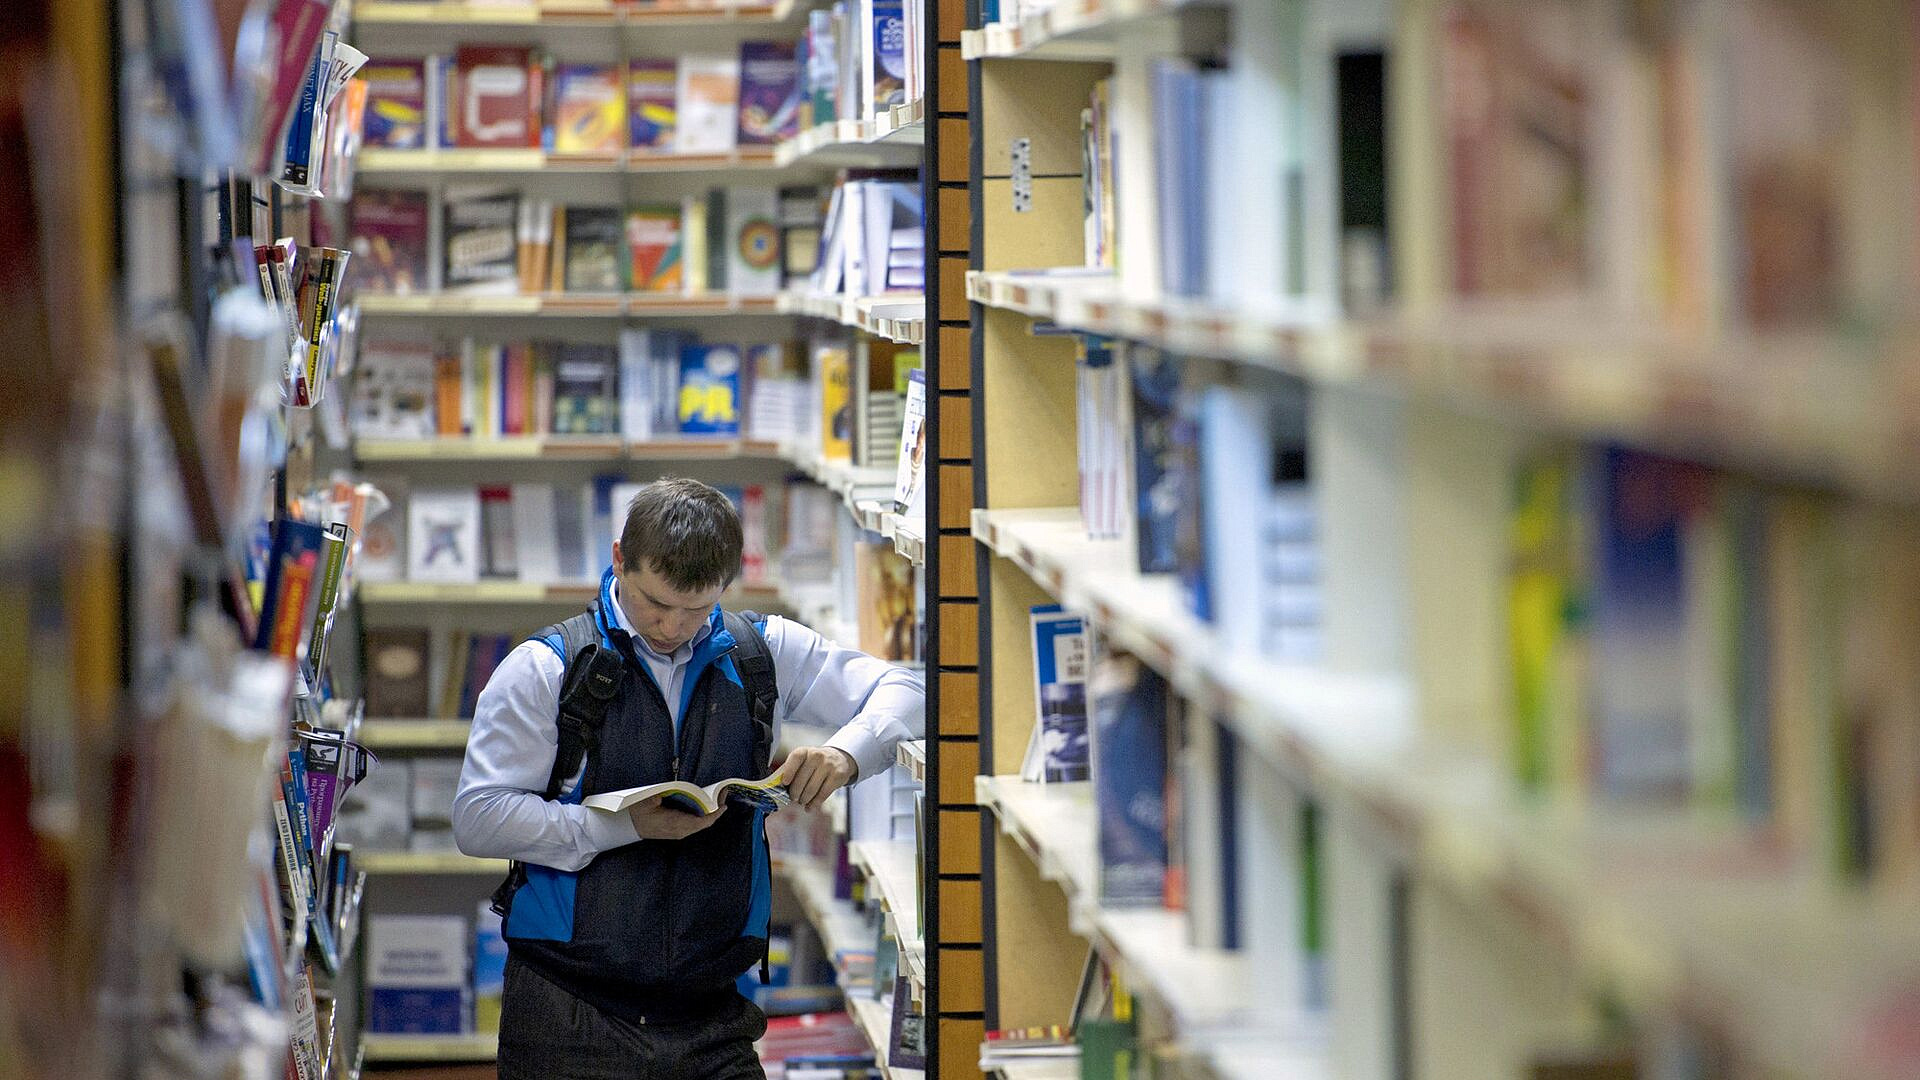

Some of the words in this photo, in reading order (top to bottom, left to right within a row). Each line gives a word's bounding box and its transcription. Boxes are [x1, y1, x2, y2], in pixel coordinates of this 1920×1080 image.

[303, 89, 313, 113] AJAX
[312, 283, 327, 342] Web-дизайна
[297, 802, 307, 836] Python
[283, 832, 297, 871] FRAMEWORK
